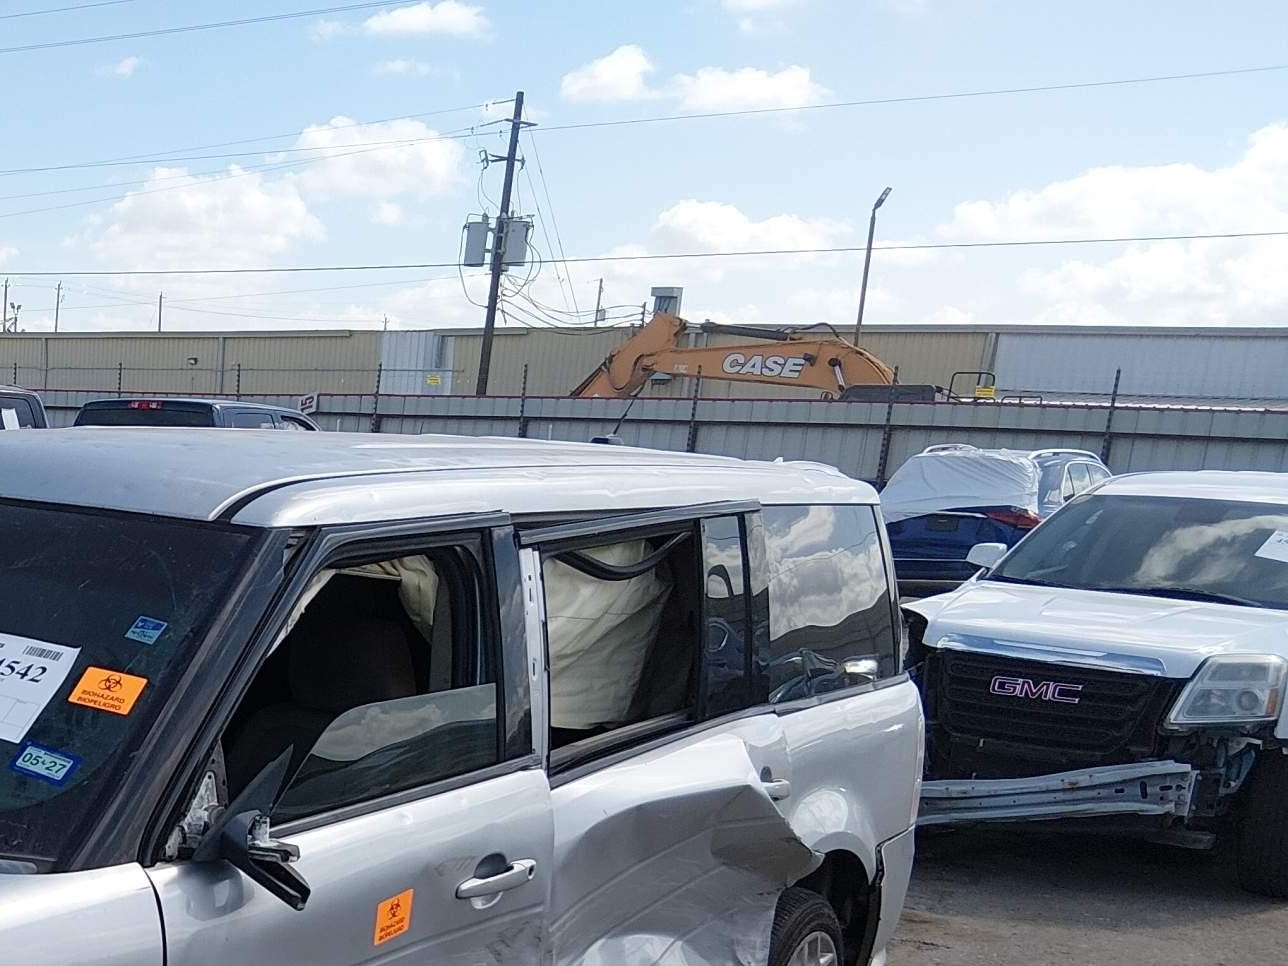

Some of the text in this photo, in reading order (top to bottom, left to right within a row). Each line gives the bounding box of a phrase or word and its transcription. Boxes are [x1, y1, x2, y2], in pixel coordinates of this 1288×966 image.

[722, 353, 806, 378] CASE
[81, 690, 125, 704] BIOHAZARD
[989, 675, 1084, 704] GMC
[76, 696, 121, 710] BIOPELIGRO
[22, 753, 42, 766] 05
[45, 760, 66, 774] 27
